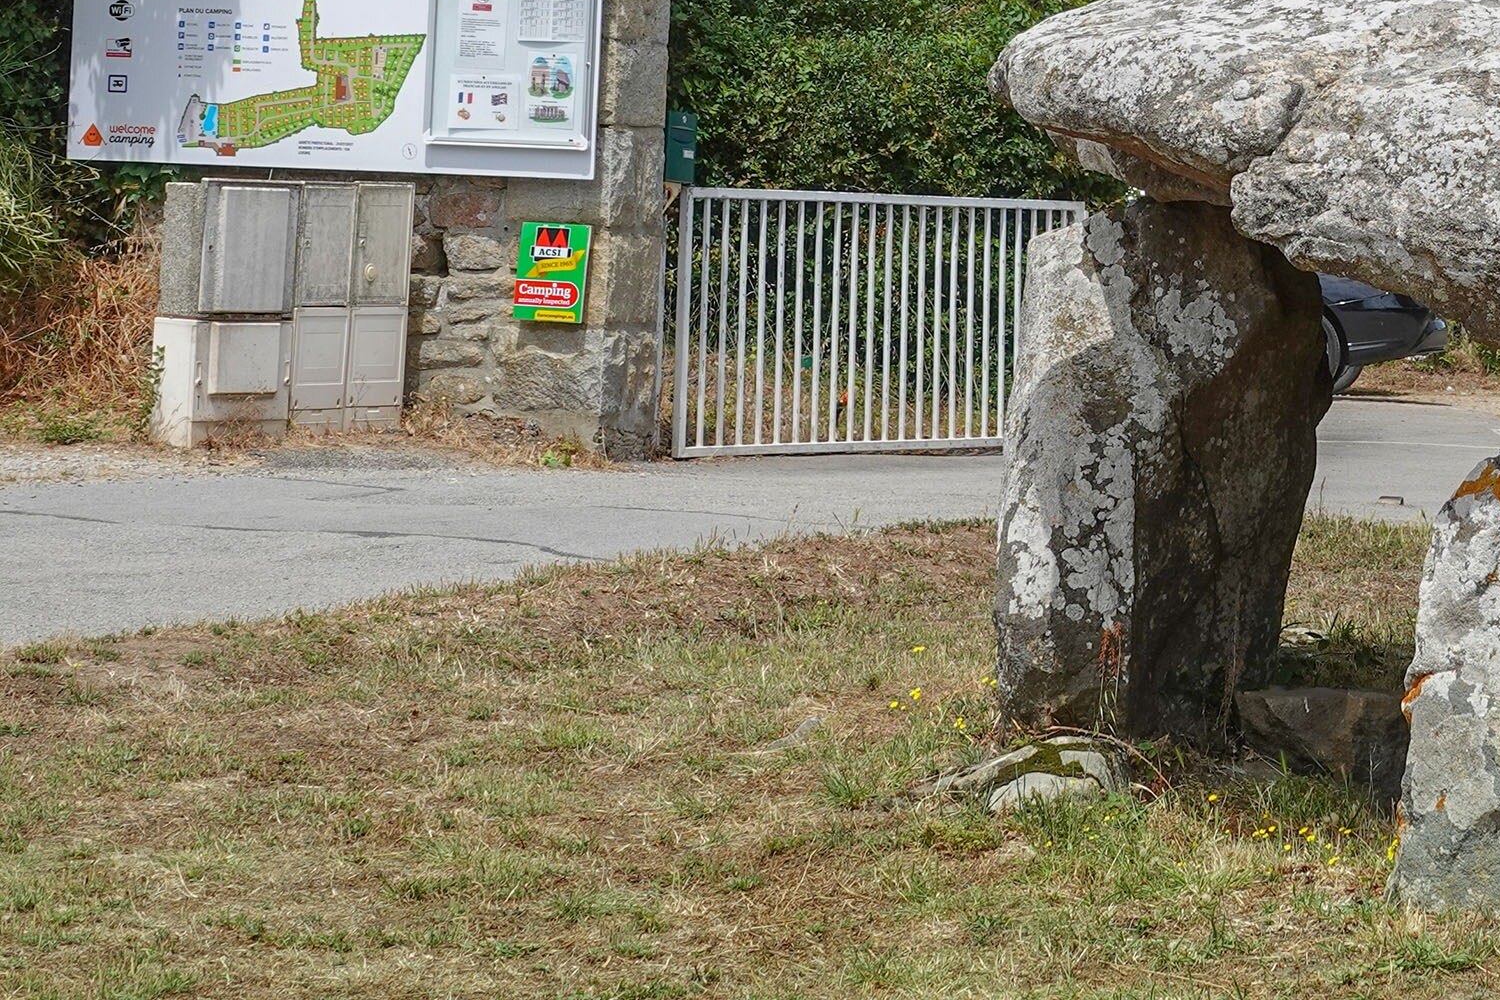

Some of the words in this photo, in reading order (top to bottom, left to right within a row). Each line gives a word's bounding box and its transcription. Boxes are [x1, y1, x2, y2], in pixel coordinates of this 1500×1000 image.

[109, 124, 156, 135] welcome
[109, 133, 155, 148] camping
[538, 248, 561, 257] ACSI
[518, 283, 572, 299] Camping
[518, 297, 543, 305] annually
[543, 298, 571, 306] inspected
